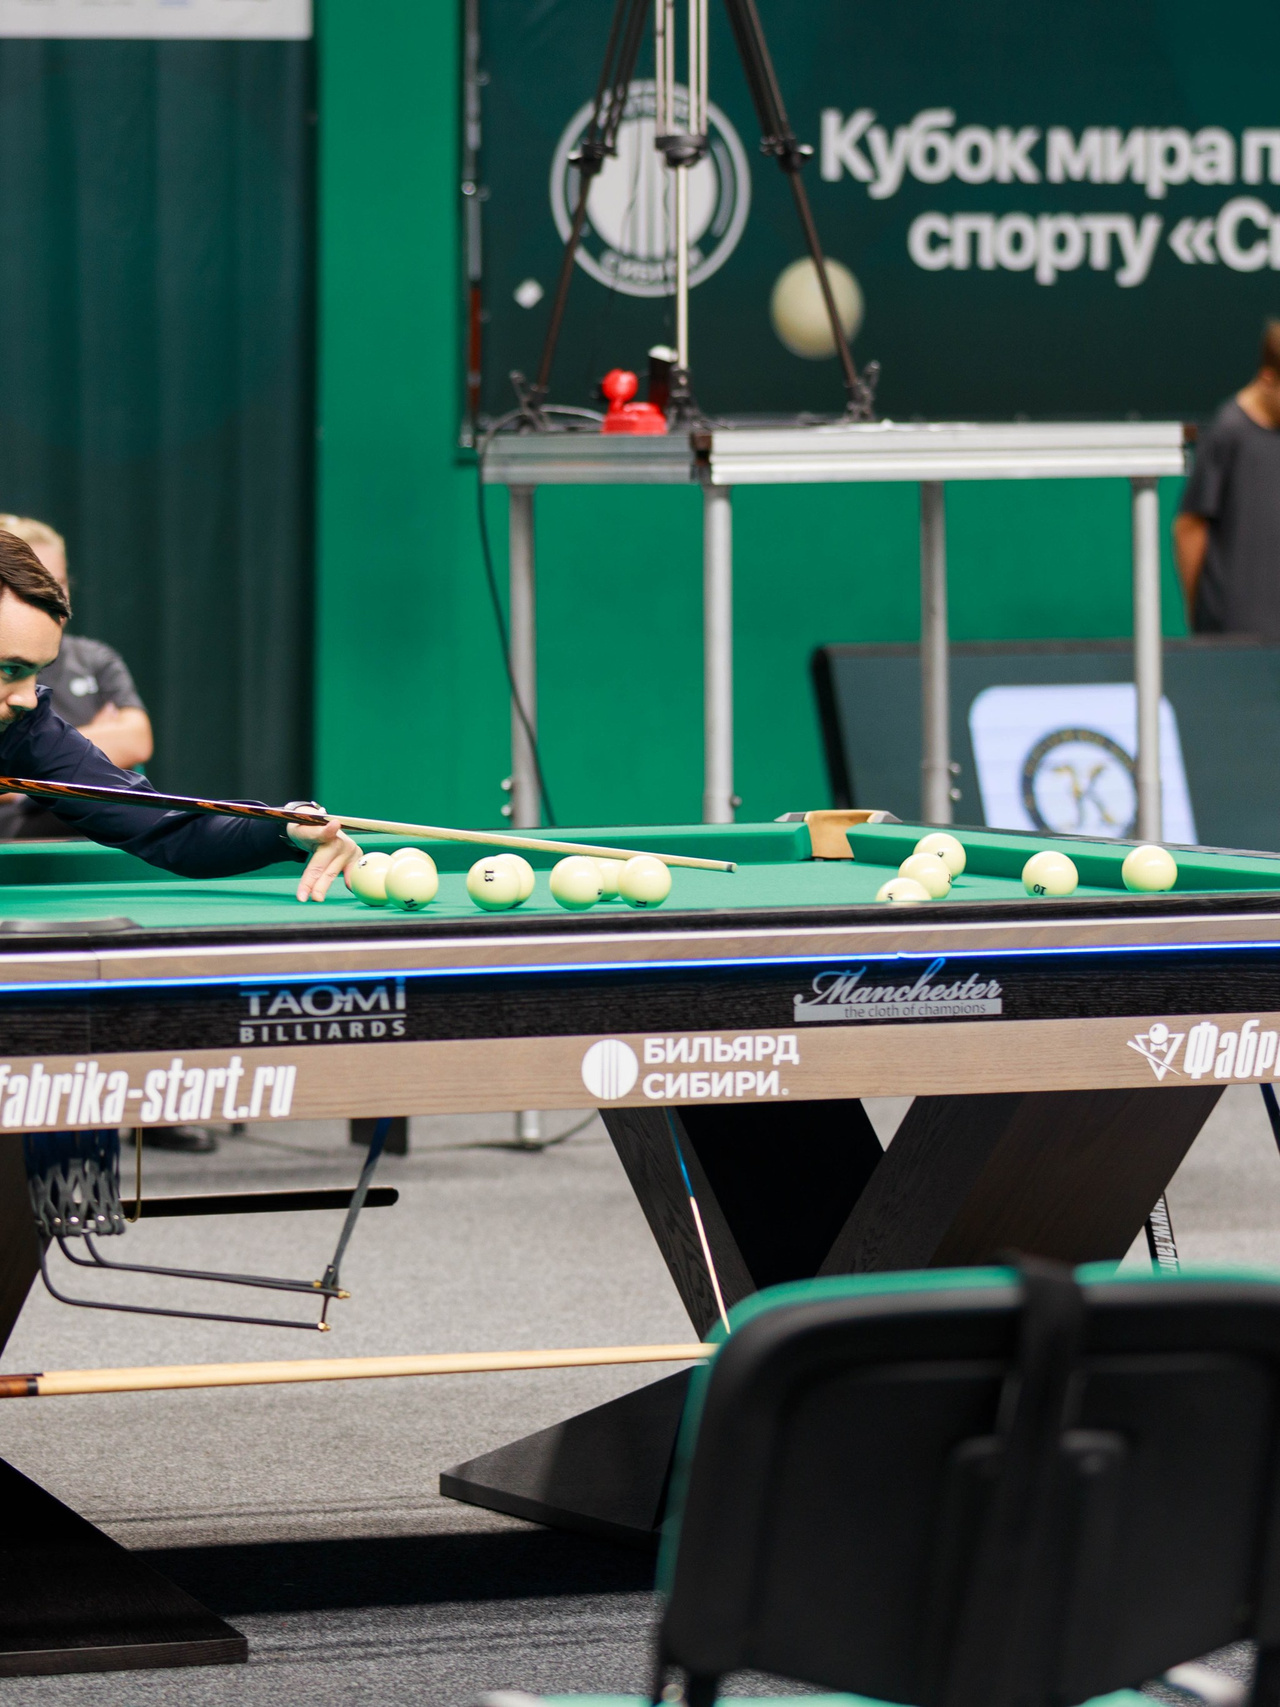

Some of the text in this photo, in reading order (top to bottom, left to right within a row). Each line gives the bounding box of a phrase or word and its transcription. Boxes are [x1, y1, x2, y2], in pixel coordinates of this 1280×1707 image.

[820, 106, 1041, 200] Кубок
[1046, 126, 1236, 200] мира
[907, 210, 1163, 288] спорту
[484, 869, 495, 882] 13
[793, 957, 1003, 1007] Manchester
[844, 1001, 987, 1019] the cloth of champions
[240, 1020, 406, 1043] BILLIARDS
[643, 1034, 800, 1065] БИЛЬЯРД
[1183, 1019, 1280, 1080] Фабр
